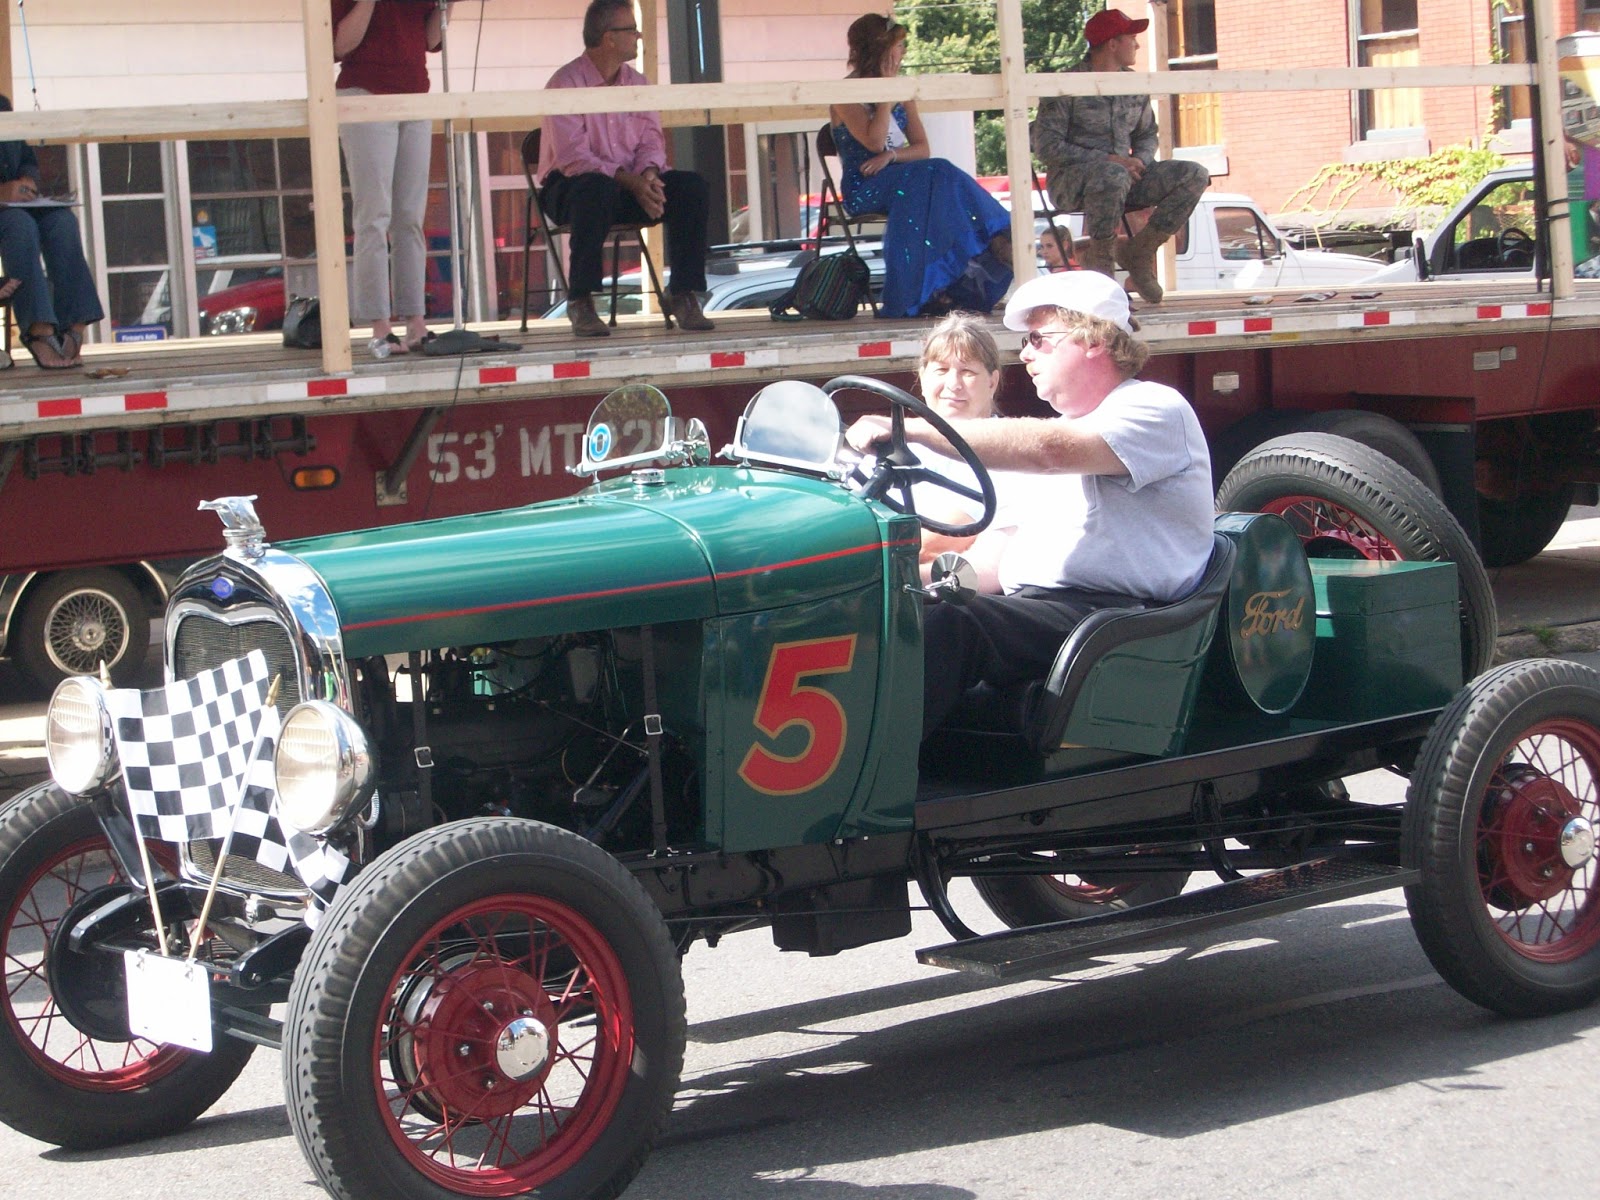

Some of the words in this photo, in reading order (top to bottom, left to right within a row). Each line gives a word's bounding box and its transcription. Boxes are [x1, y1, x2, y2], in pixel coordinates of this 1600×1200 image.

[427, 423, 504, 484] 53'
[1240, 587, 1305, 640] Ford
[737, 633, 858, 796] 5
